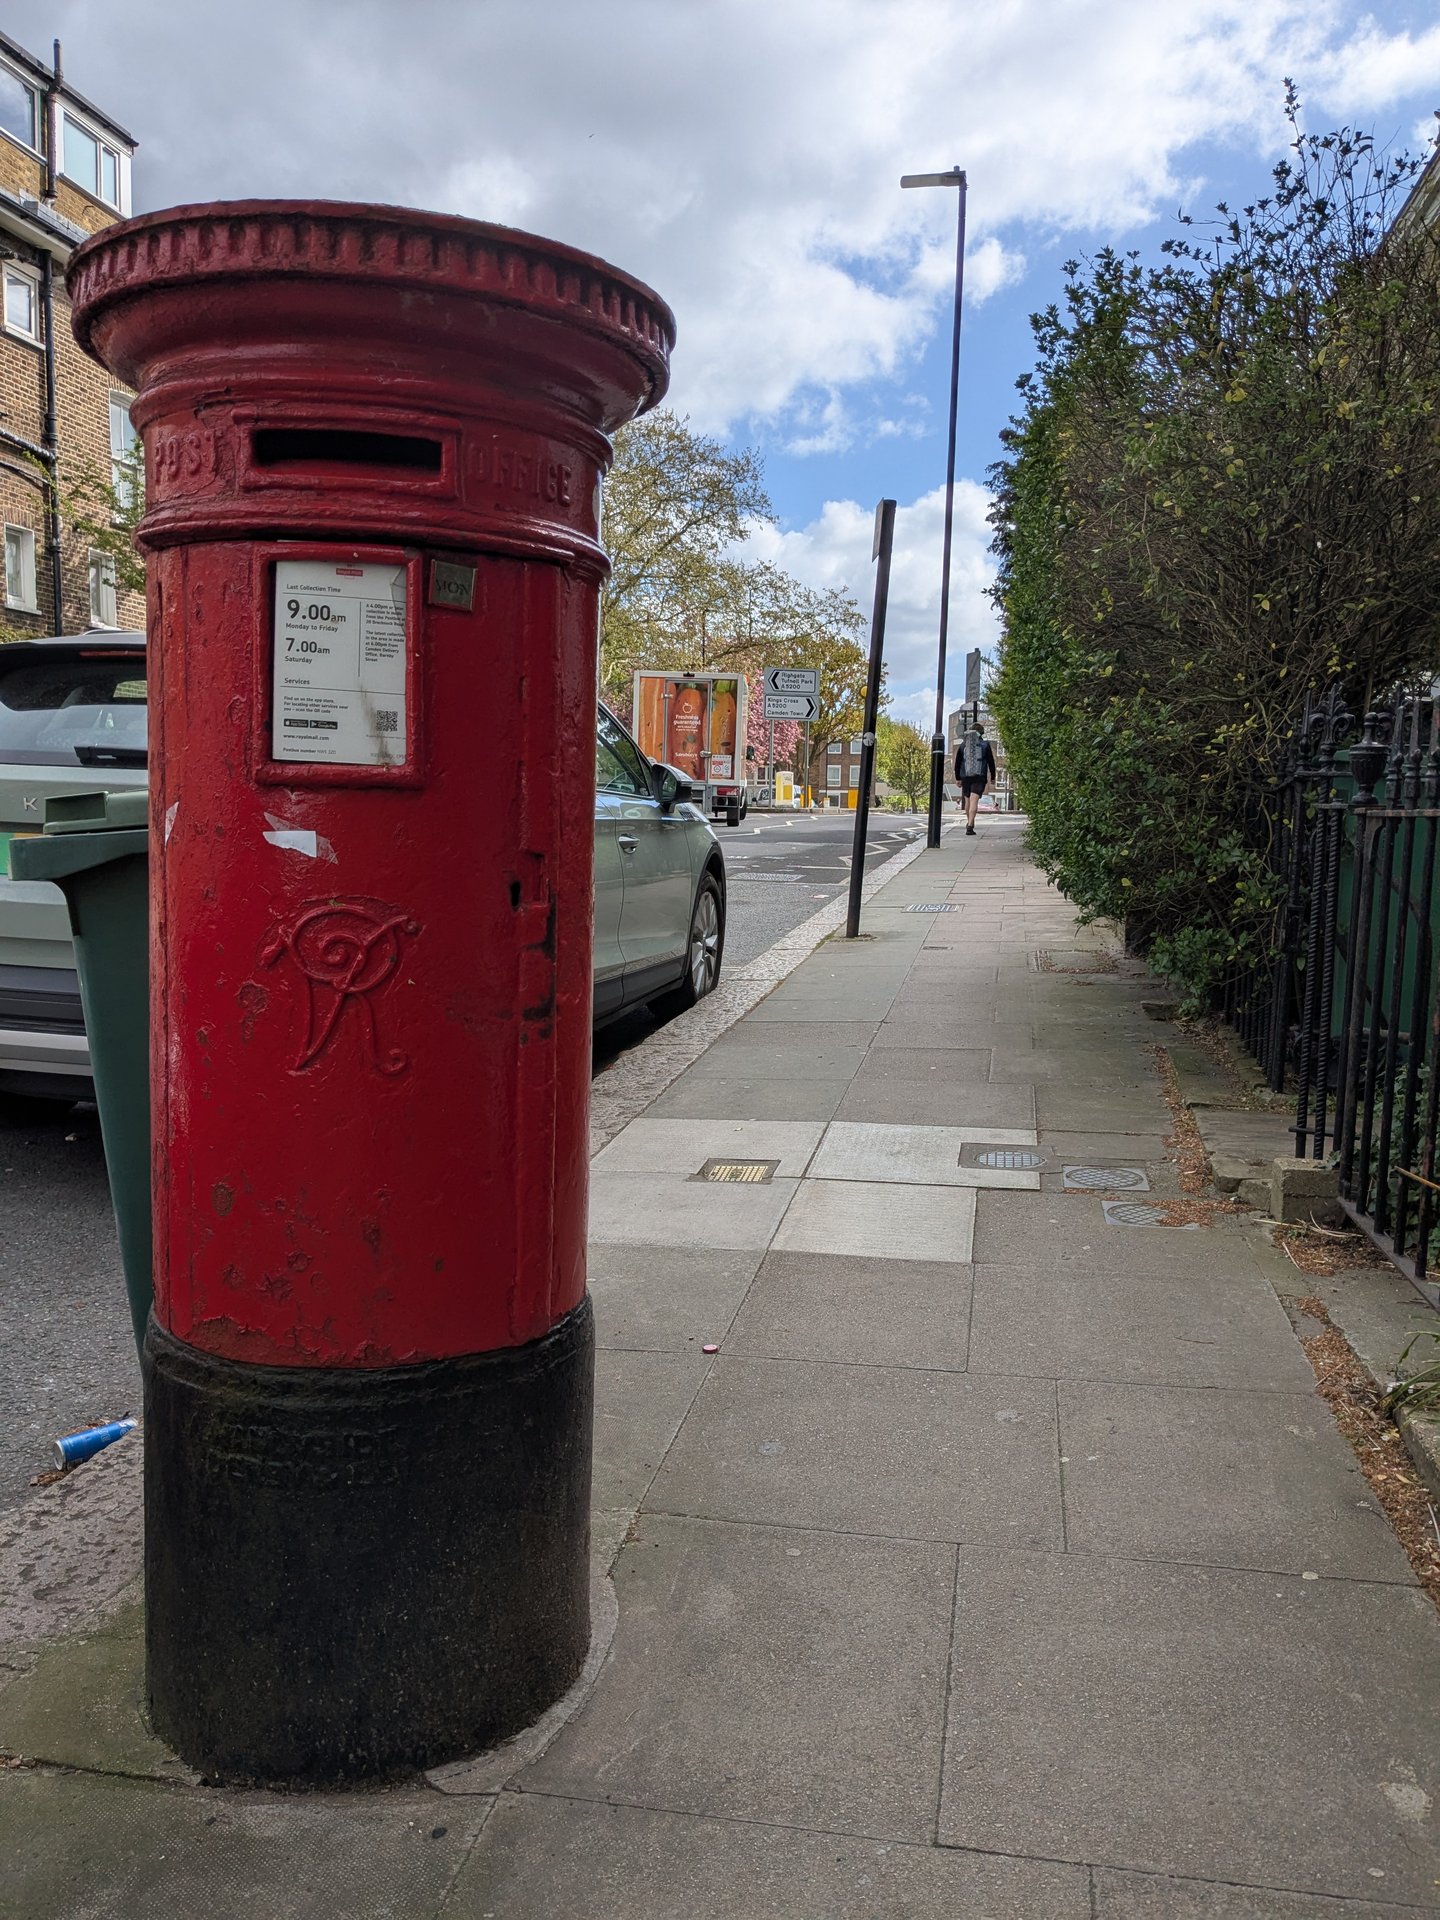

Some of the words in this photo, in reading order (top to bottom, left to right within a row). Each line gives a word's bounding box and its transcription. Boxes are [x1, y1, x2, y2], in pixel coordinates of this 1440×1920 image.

[154, 427, 222, 485] POST
[467, 443, 573, 505] OFFICE
[287, 599, 346, 622] 9.00am
[286, 622, 310, 631] Monday
[286, 637, 330, 654] 7.00am
[284, 656, 312, 664] Saturday
